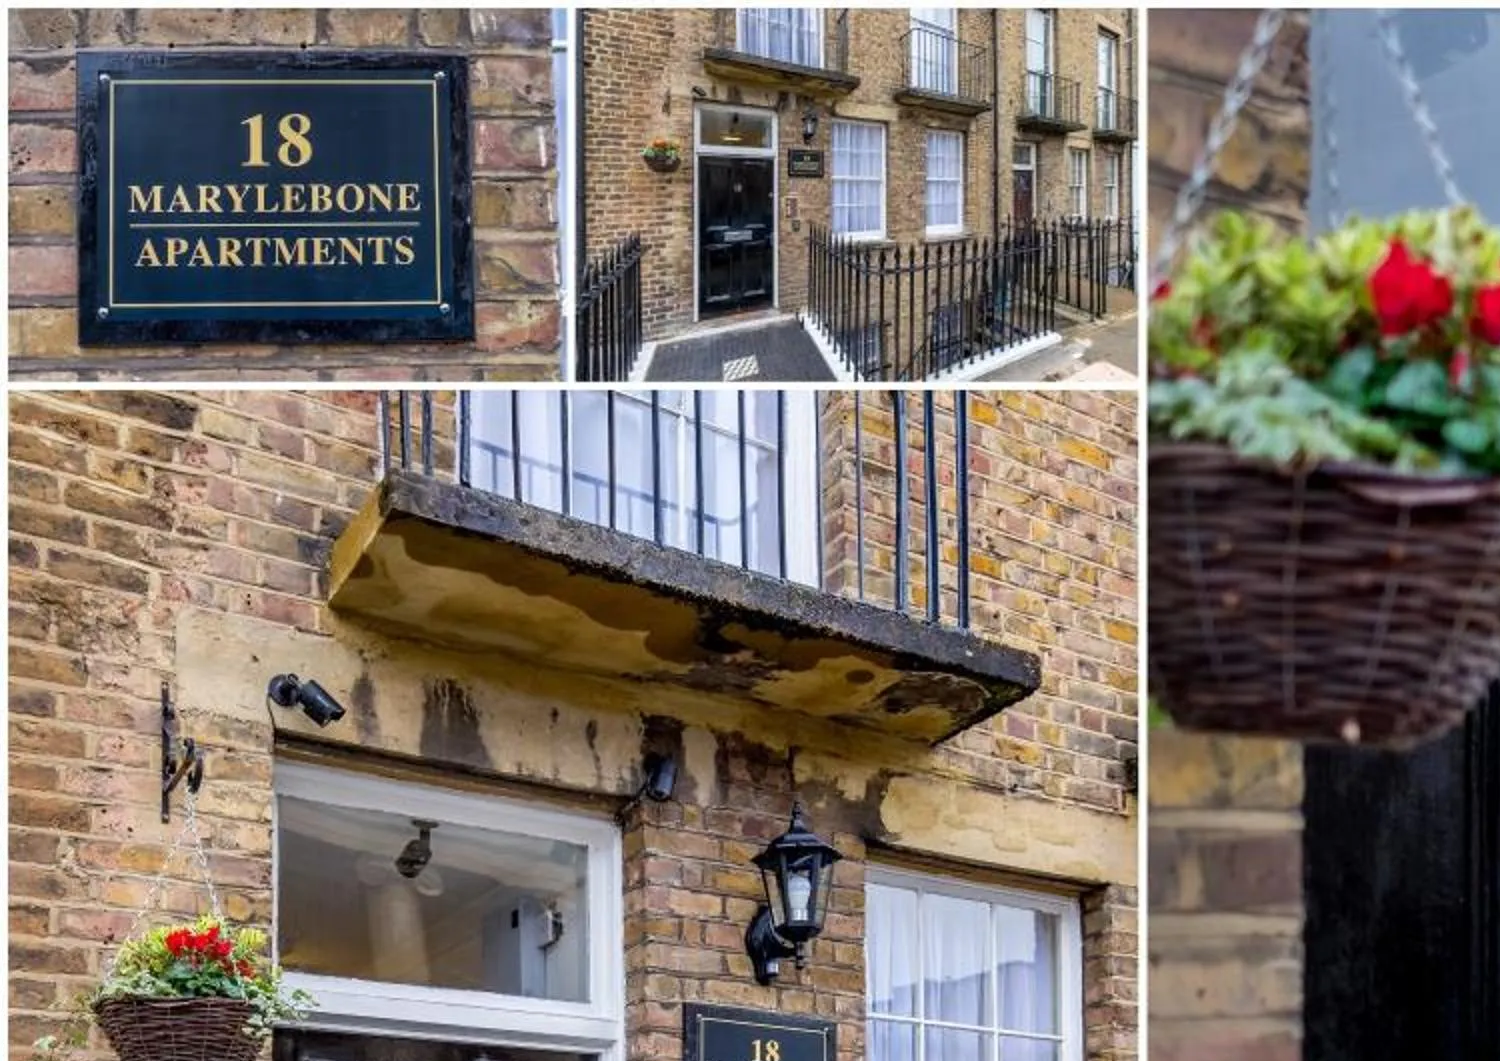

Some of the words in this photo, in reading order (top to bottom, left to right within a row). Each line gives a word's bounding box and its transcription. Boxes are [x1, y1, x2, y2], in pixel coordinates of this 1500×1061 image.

[240, 113, 313, 168] 18
[128, 183, 421, 214] MARYLEBONE
[134, 235, 416, 268] APARTMENTS
